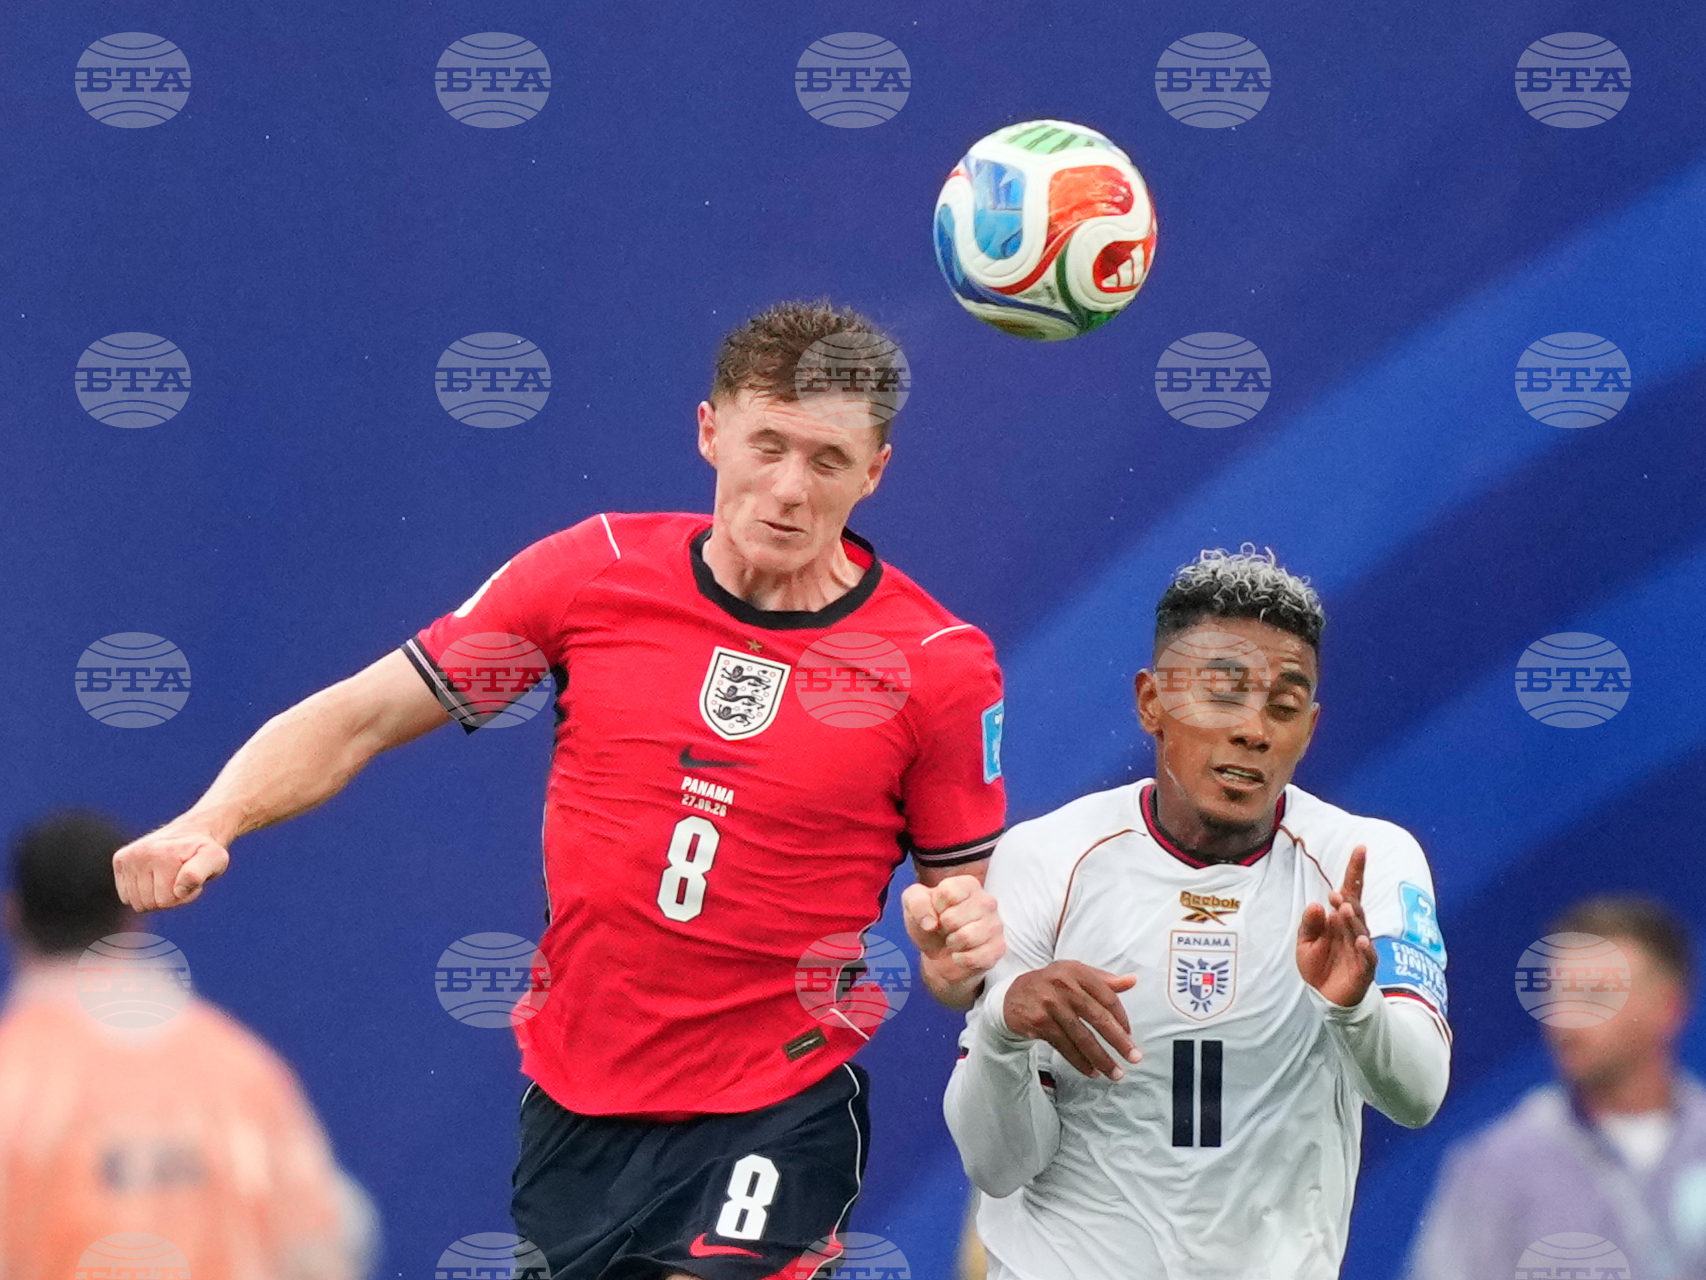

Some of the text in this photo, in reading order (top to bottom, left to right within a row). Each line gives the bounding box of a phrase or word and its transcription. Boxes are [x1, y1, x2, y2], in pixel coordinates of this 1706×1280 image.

[681, 776, 734, 805] PANAMA
[682, 794, 727, 817] 27.06.26
[657, 815, 721, 922] 8
[1180, 890, 1240, 909] Reebok
[1177, 937, 1231, 947] PANAMÁ
[1394, 951, 1448, 992] UNITE
[1172, 1040, 1223, 1147] 11
[716, 1154, 780, 1240] 8
